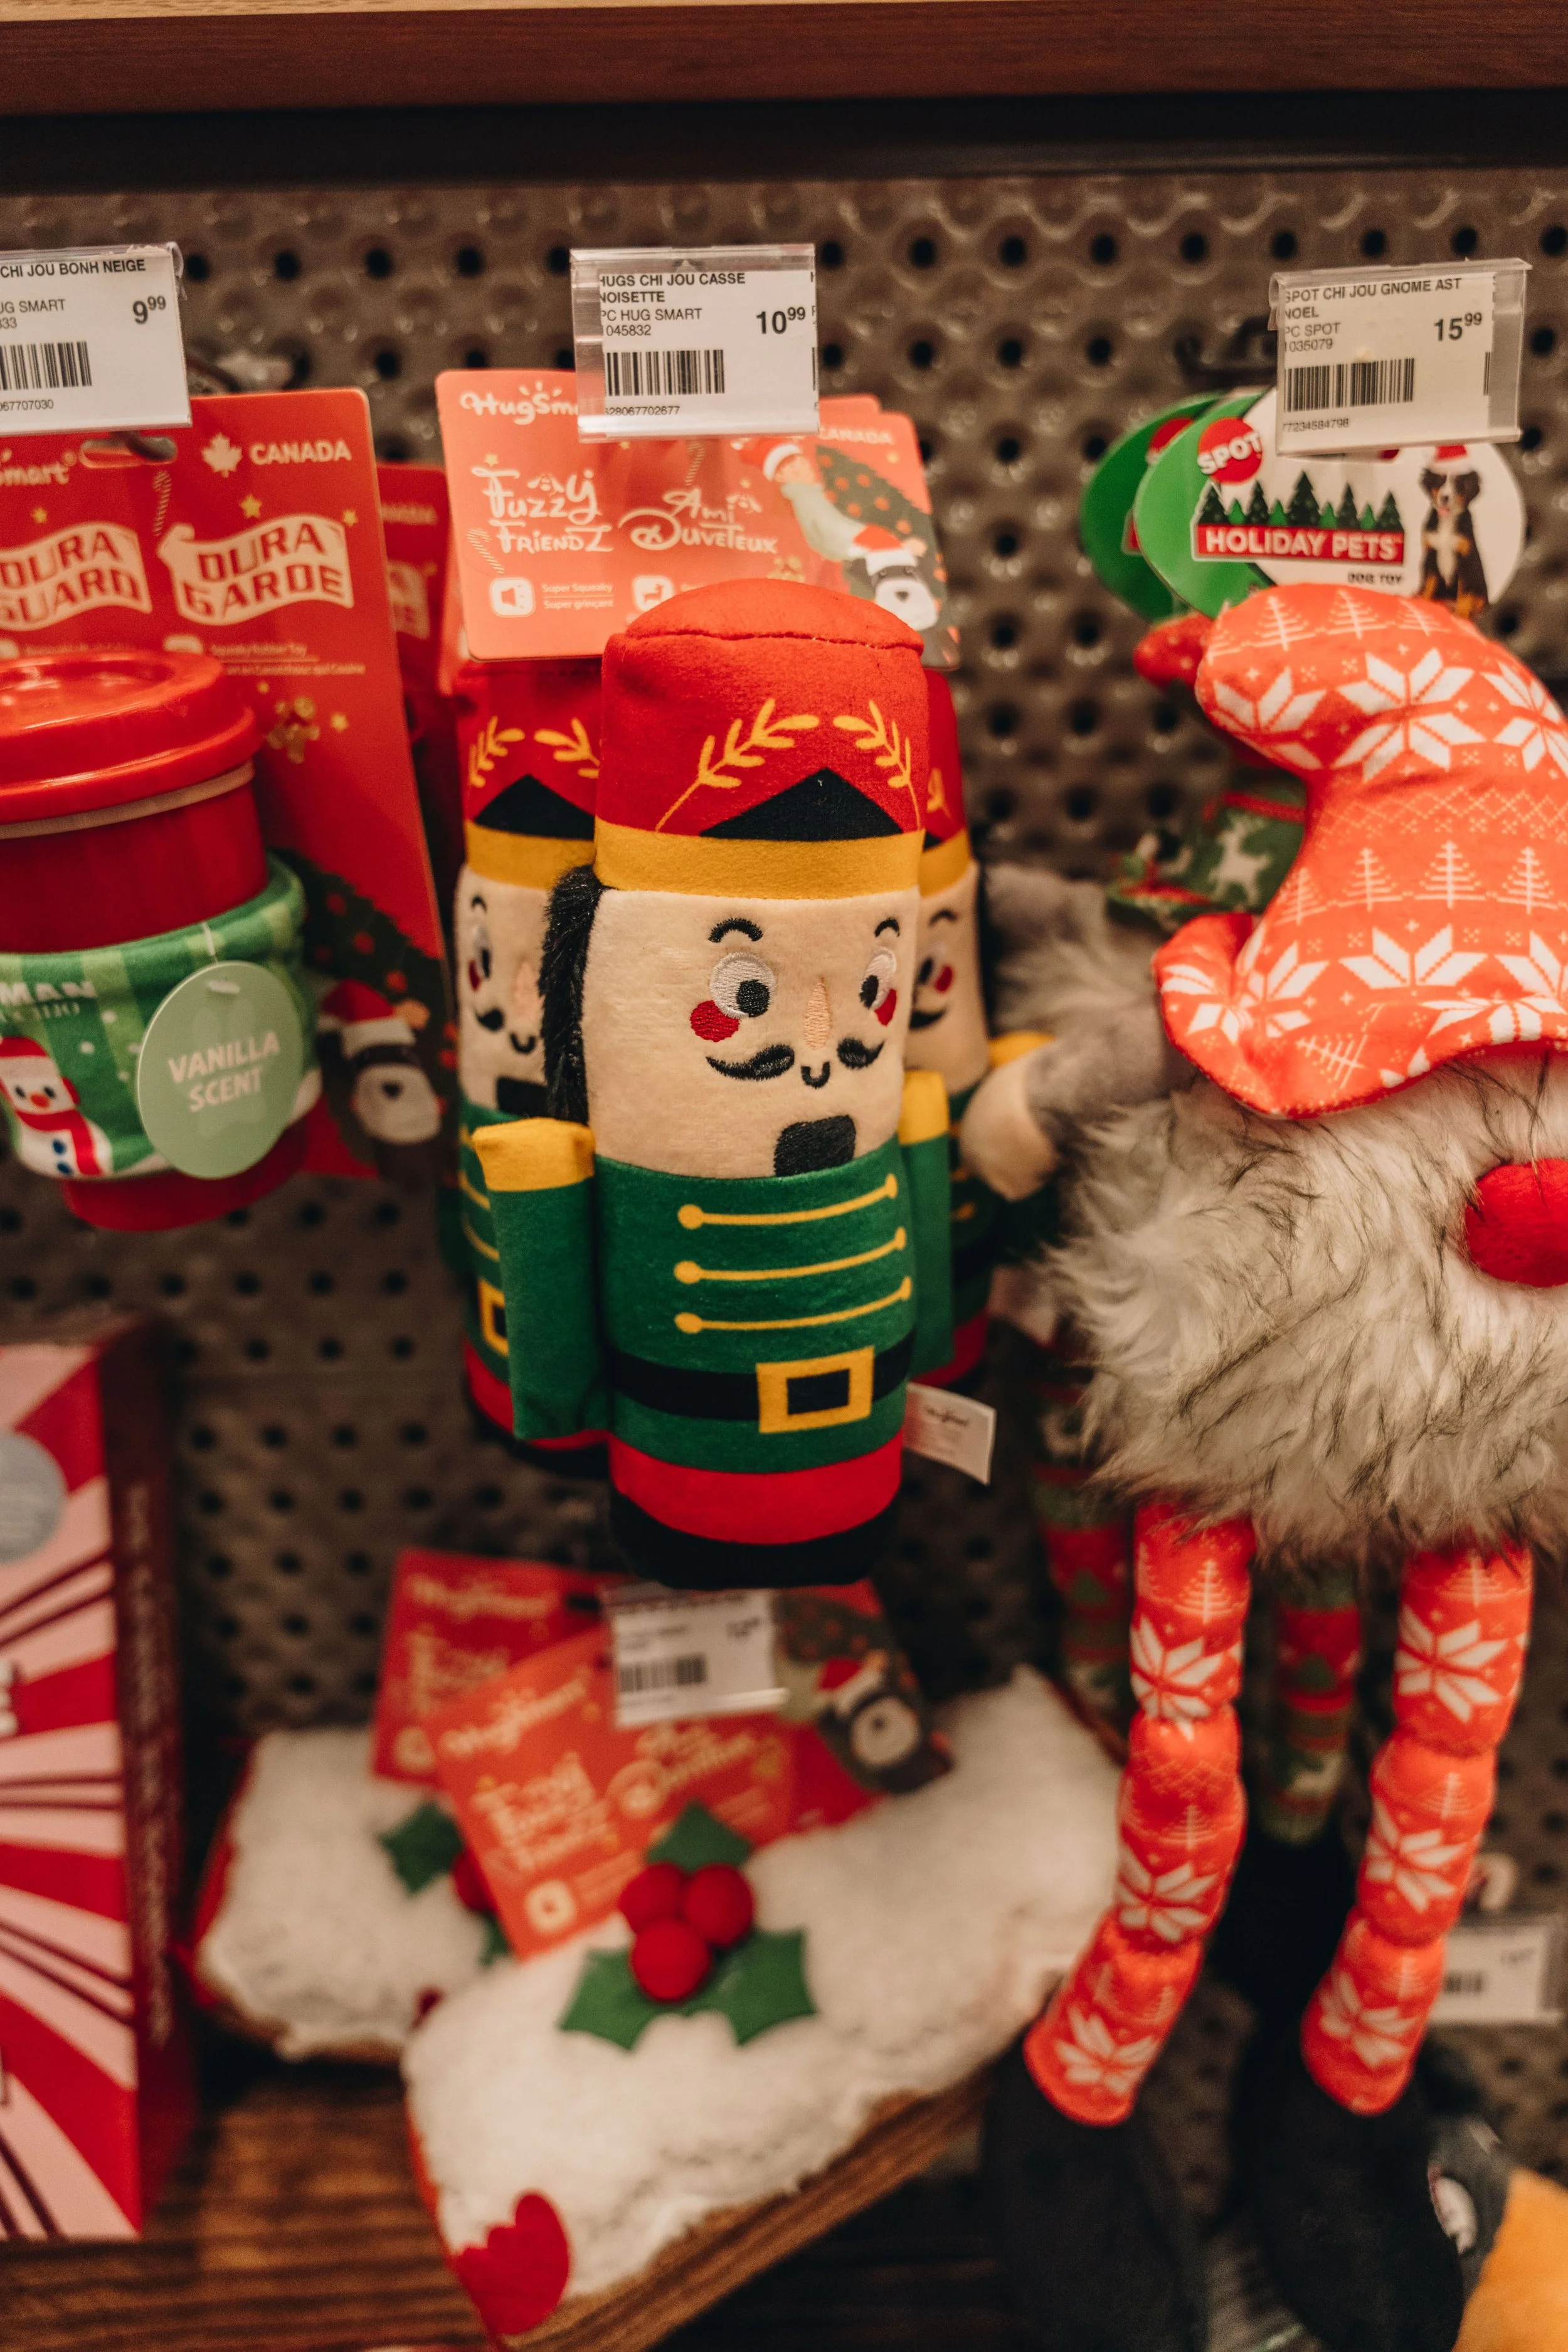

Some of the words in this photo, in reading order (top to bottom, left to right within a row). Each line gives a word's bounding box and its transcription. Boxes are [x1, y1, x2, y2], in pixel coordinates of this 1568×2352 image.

[1, 265, 23, 277] CHI
[27, 263, 55, 277] JOU
[60, 261, 98, 275] BONH
[103, 259, 146, 273] NEIGE
[640, 275, 662, 286] CHI
[667, 273, 696, 286] JOU
[699, 272, 746, 285] CASSE
[1323, 286, 1345, 300] CHI
[1350, 284, 1376, 298] JOU
[1381, 280, 1431, 295] GNOME
[1435, 277, 1462, 290] AST
[19, 299, 66, 313] SMART
[600, 291, 665, 303] NOISETTE
[621, 309, 650, 321] HUG
[655, 308, 702, 320] SMART
[1285, 306, 1319, 320] NOEL
[1305, 322, 1340, 337] SPOT
[251, 440, 352, 465] CANADA
[1197, 432, 1263, 475] SPOT
[197, 522, 326, 583] DURA
[1205, 529, 1325, 557] HOLIDAY
[1332, 533, 1396, 561] PETS
[1380, 573, 1403, 586] TOY
[182, 564, 344, 618] GARDE
[169, 1030, 280, 1084] VANILLA
[189, 1069, 263, 1113] SCENT
